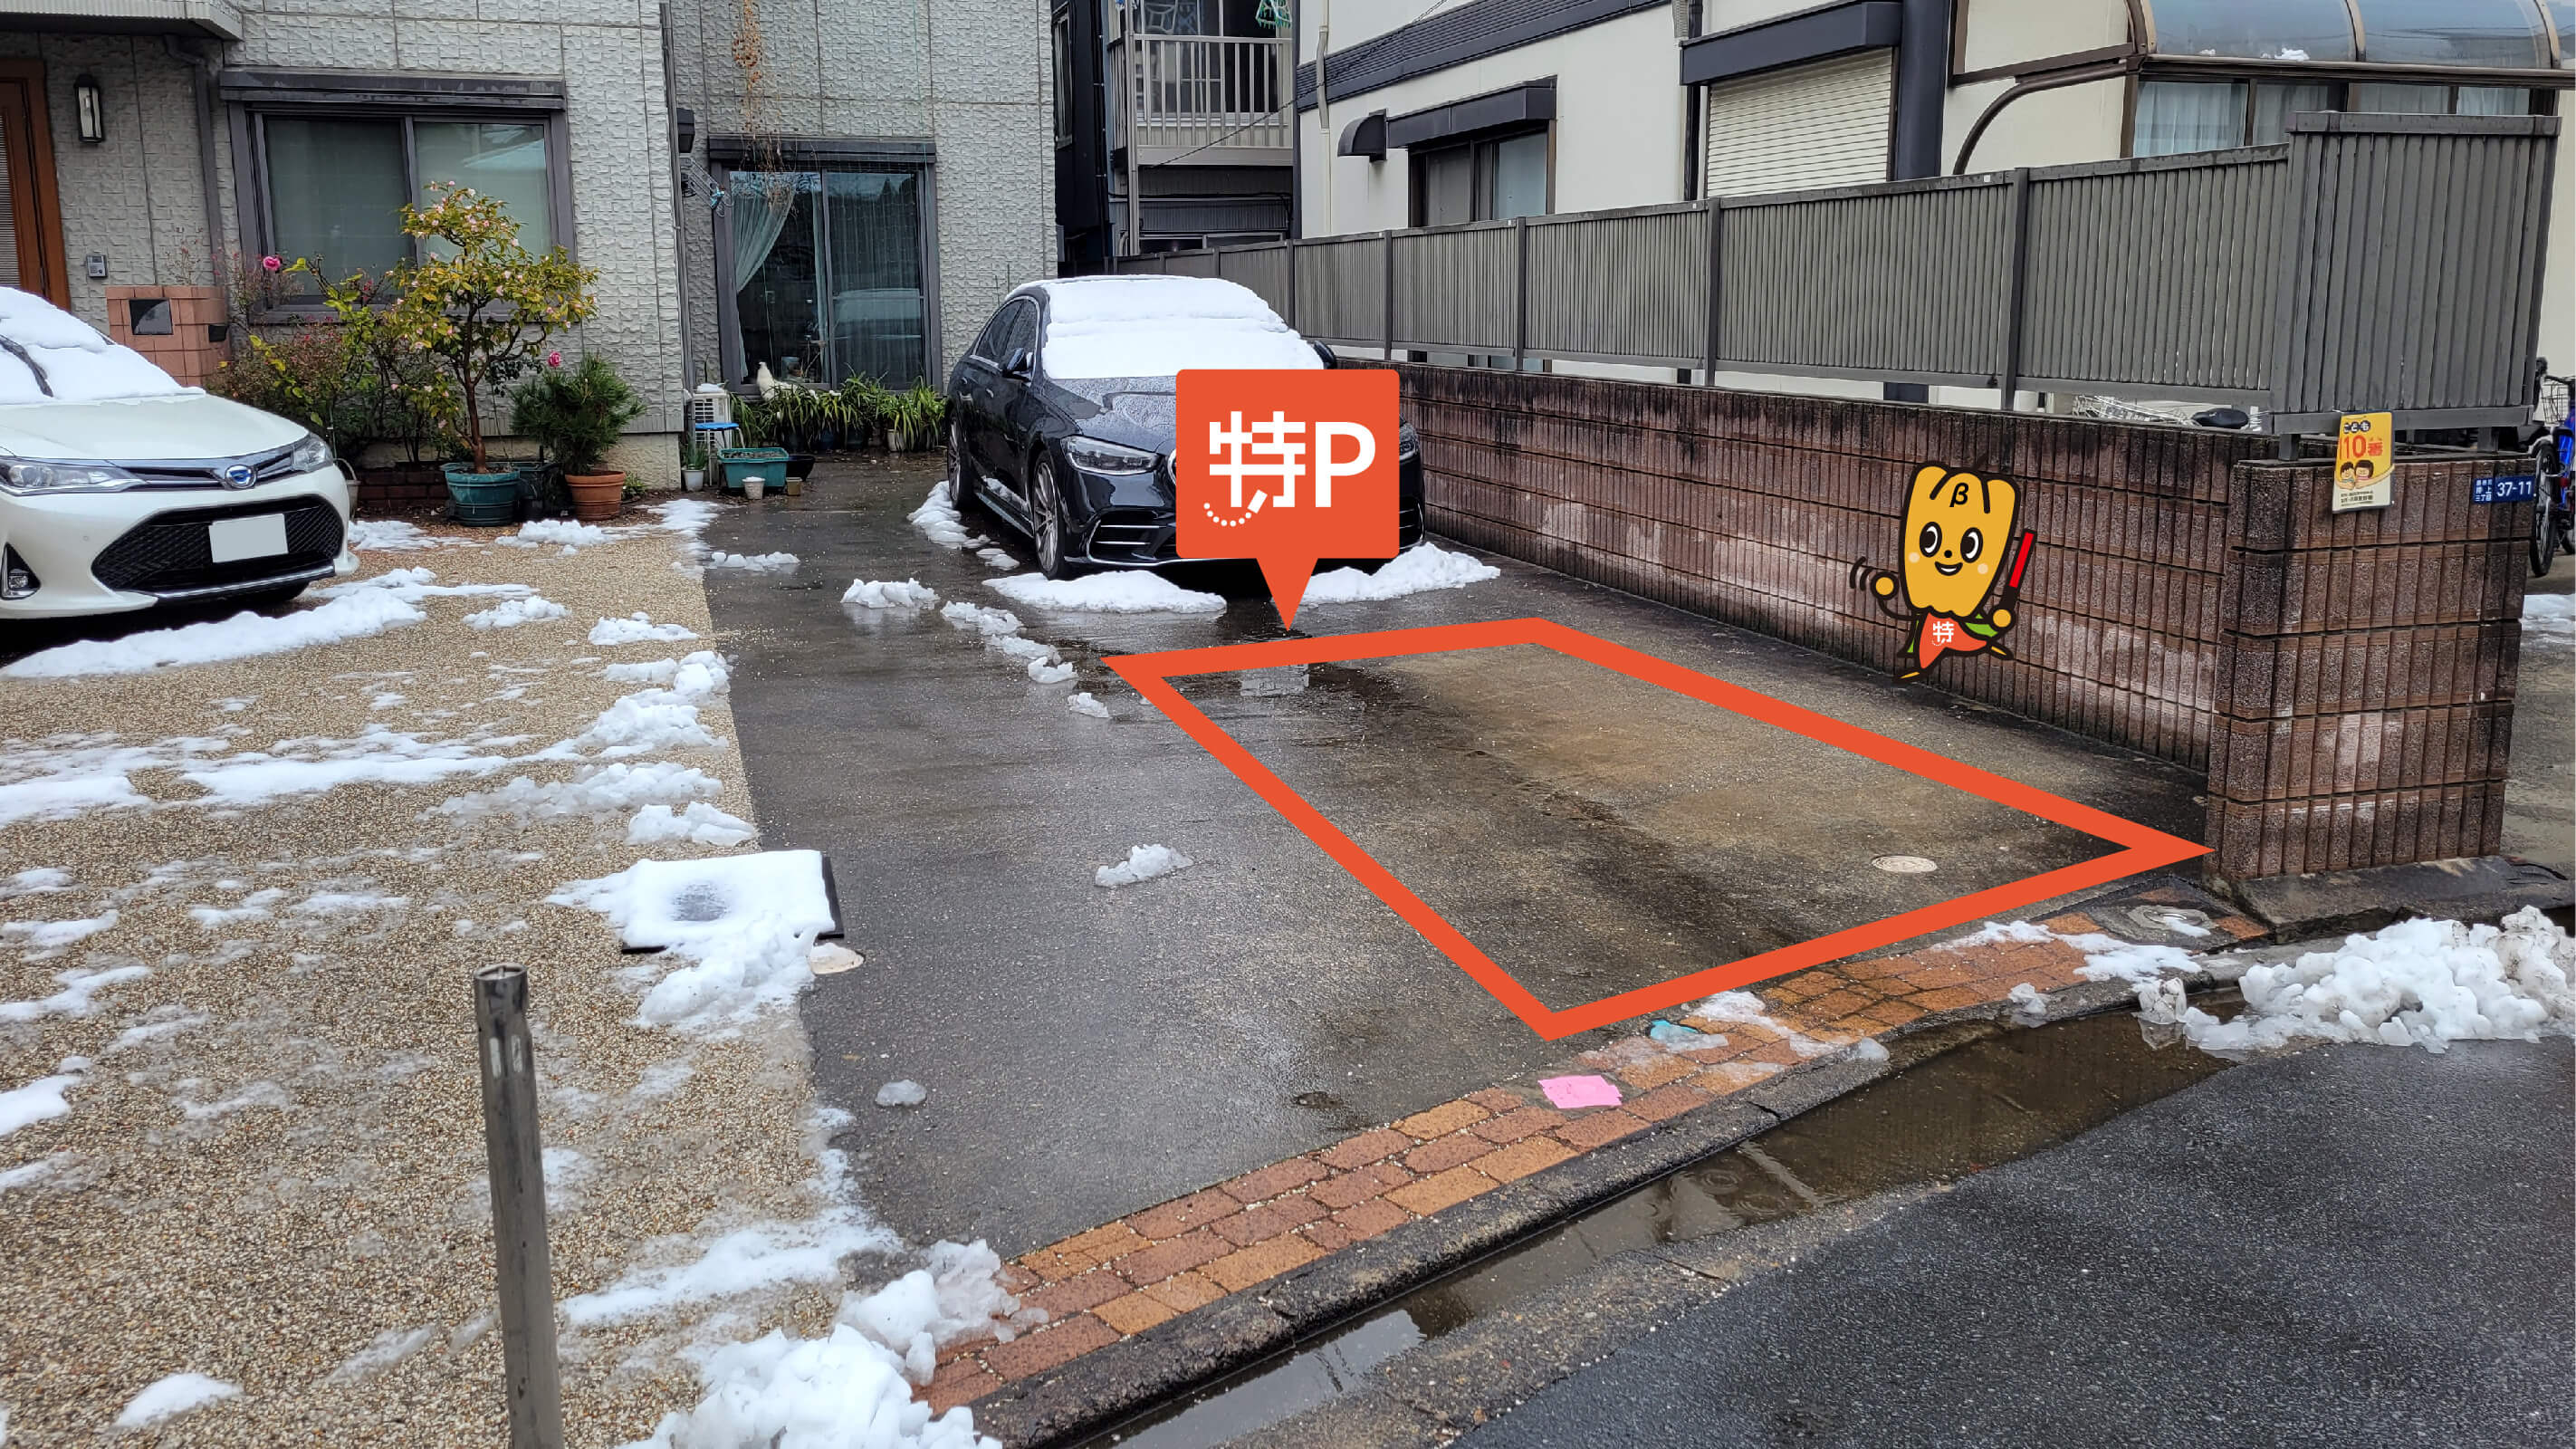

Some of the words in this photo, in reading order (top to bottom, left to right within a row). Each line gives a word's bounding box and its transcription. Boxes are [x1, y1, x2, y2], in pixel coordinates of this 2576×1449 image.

[2343, 421, 2370, 434] こども
[2496, 481, 2532, 496] 37-11
